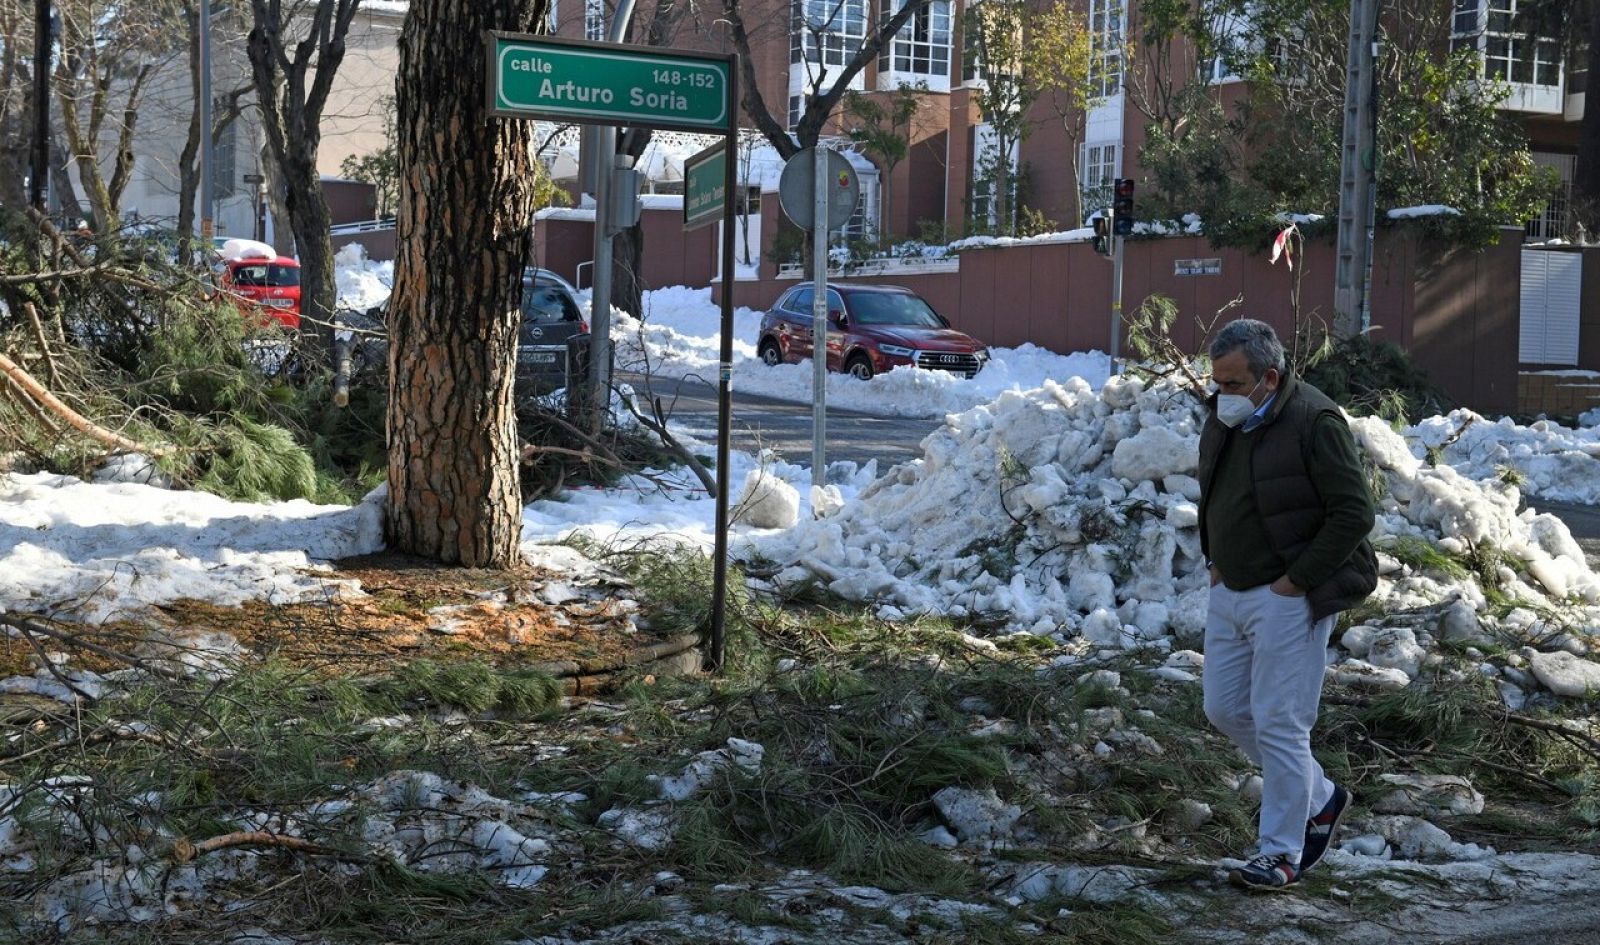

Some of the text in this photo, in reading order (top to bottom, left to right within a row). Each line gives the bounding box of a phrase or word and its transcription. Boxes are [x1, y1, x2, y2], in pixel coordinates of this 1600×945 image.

[511, 58, 552, 73] calle
[653, 69, 715, 88] 148-152
[538, 78, 688, 111] Arturo Soria
